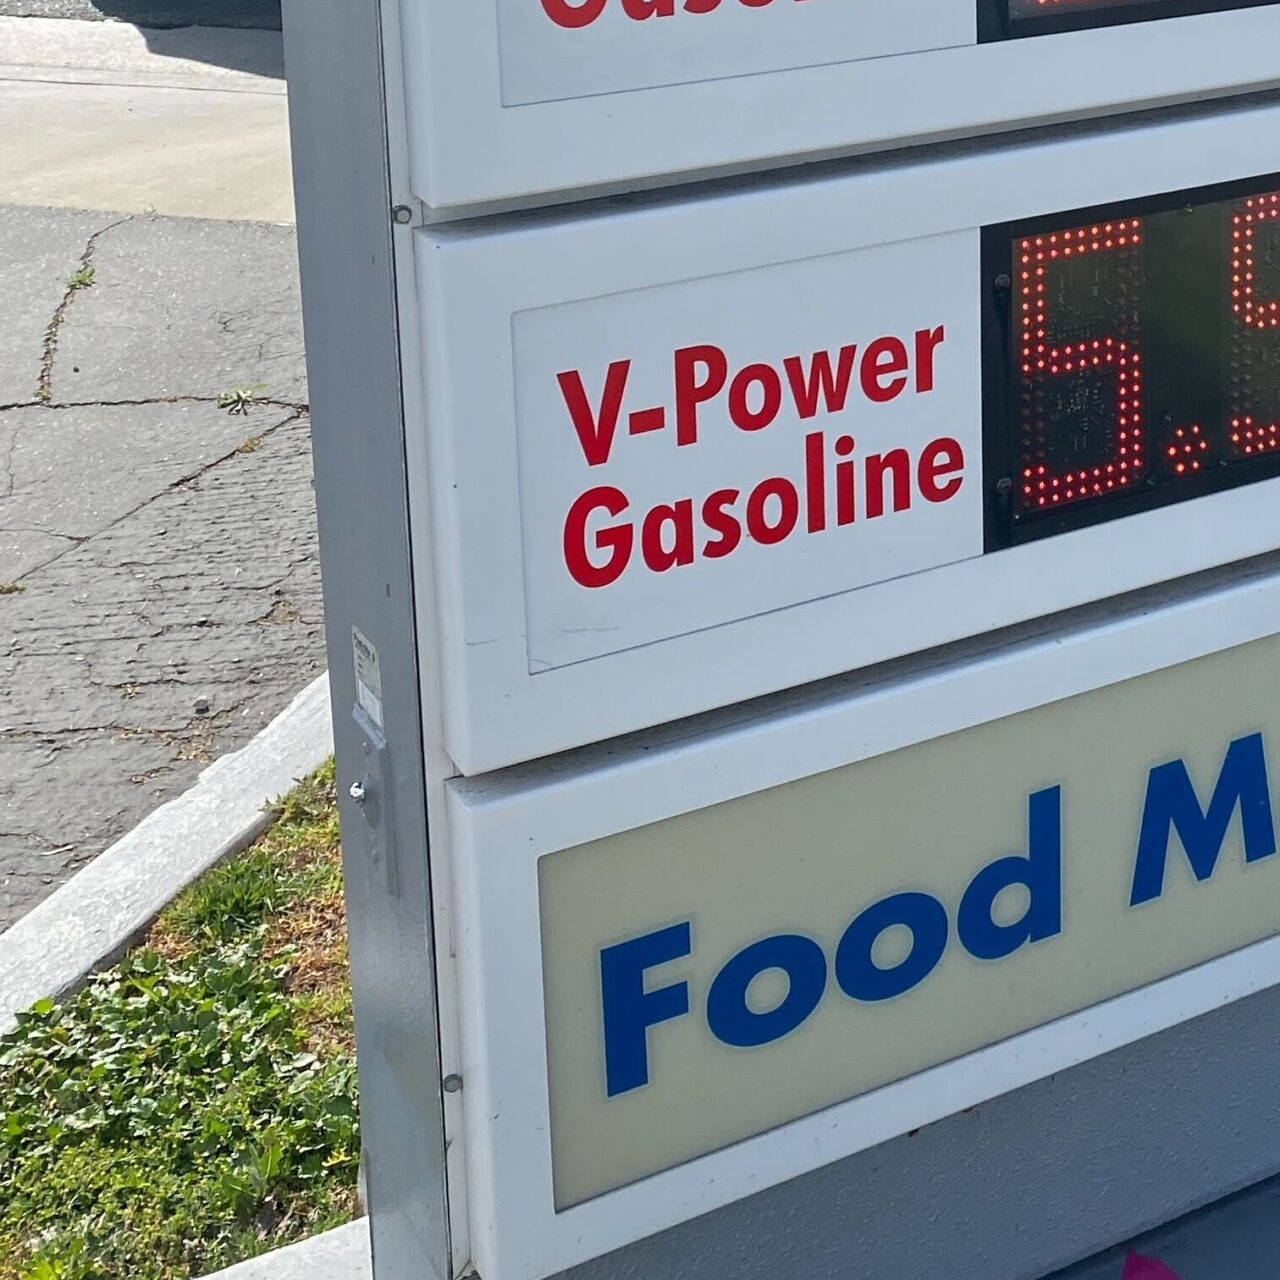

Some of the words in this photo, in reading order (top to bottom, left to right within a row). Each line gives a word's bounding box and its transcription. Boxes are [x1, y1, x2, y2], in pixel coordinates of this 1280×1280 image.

[556, 325, 944, 466] V-Power
[563, 431, 964, 588] Gasoline
[600, 784, 1062, 1098] Food
